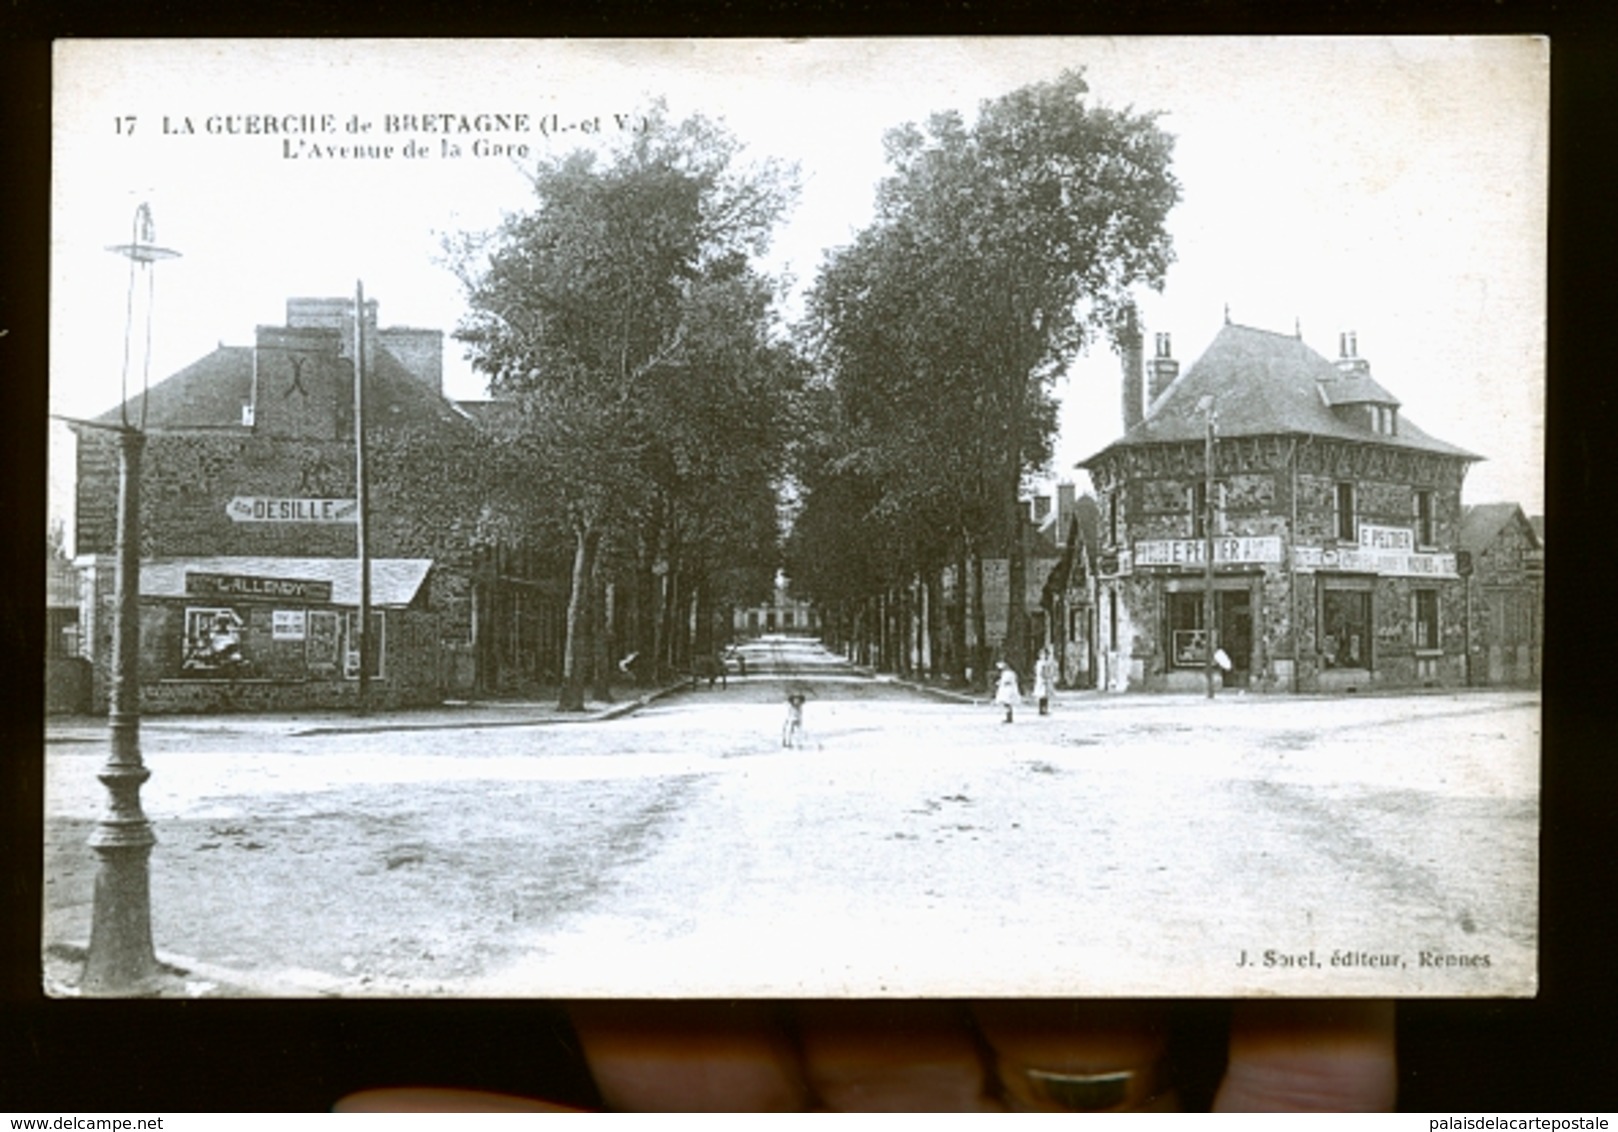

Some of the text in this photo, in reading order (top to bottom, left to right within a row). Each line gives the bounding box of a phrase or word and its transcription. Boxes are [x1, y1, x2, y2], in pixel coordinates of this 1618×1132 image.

[113, 116, 138, 136] 17
[162, 116, 197, 136] LA
[205, 115, 336, 136] GUERCHE
[346, 115, 373, 135] de
[384, 114, 531, 134] BRETAGNE
[282, 138, 395, 160] L'Avenue
[403, 139, 431, 160] de
[441, 139, 463, 160] la
[253, 499, 334, 520] DESILLE
[1235, 949, 1255, 968] J.
[1329, 948, 1407, 971] éditeur,
[1418, 950, 1492, 969] Rennes
